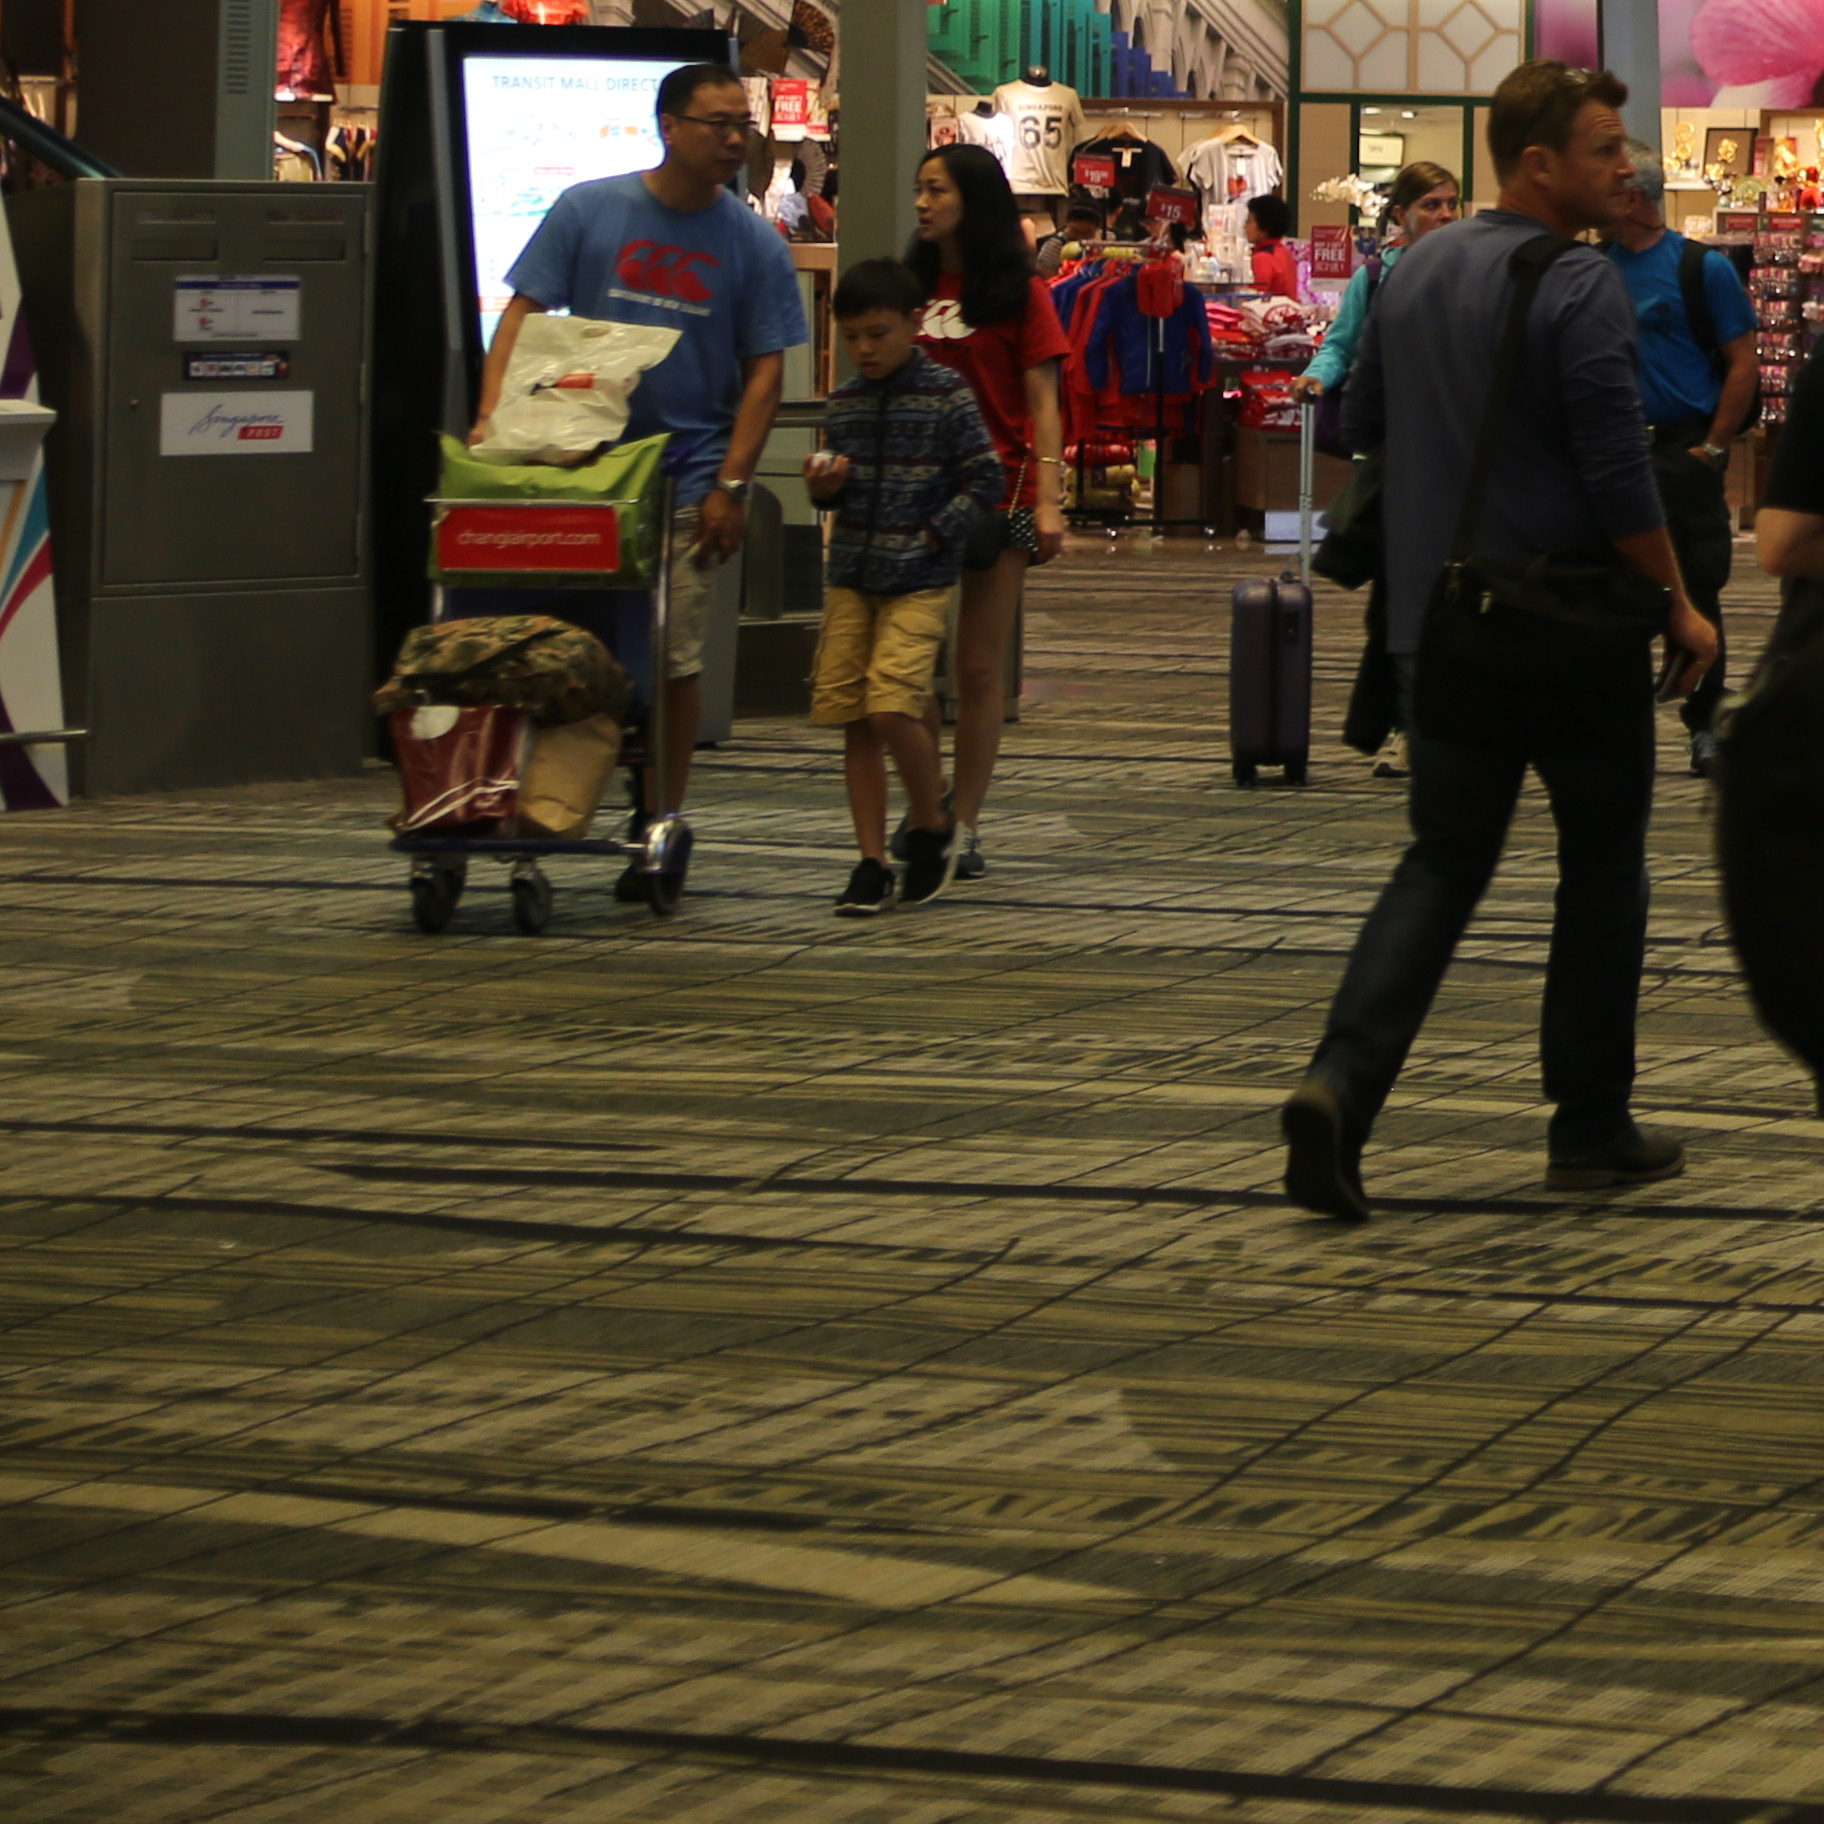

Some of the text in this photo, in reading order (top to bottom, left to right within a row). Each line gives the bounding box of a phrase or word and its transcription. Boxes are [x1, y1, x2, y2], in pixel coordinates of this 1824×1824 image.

[492, 75, 555, 90] TRANSIT
[561, 76, 601, 91] MALL
[775, 100, 802, 113] FREE
[1019, 115, 1063, 149] 65
[1314, 248, 1346, 262] FREE
[457, 529, 602, 549] changiairport.com
